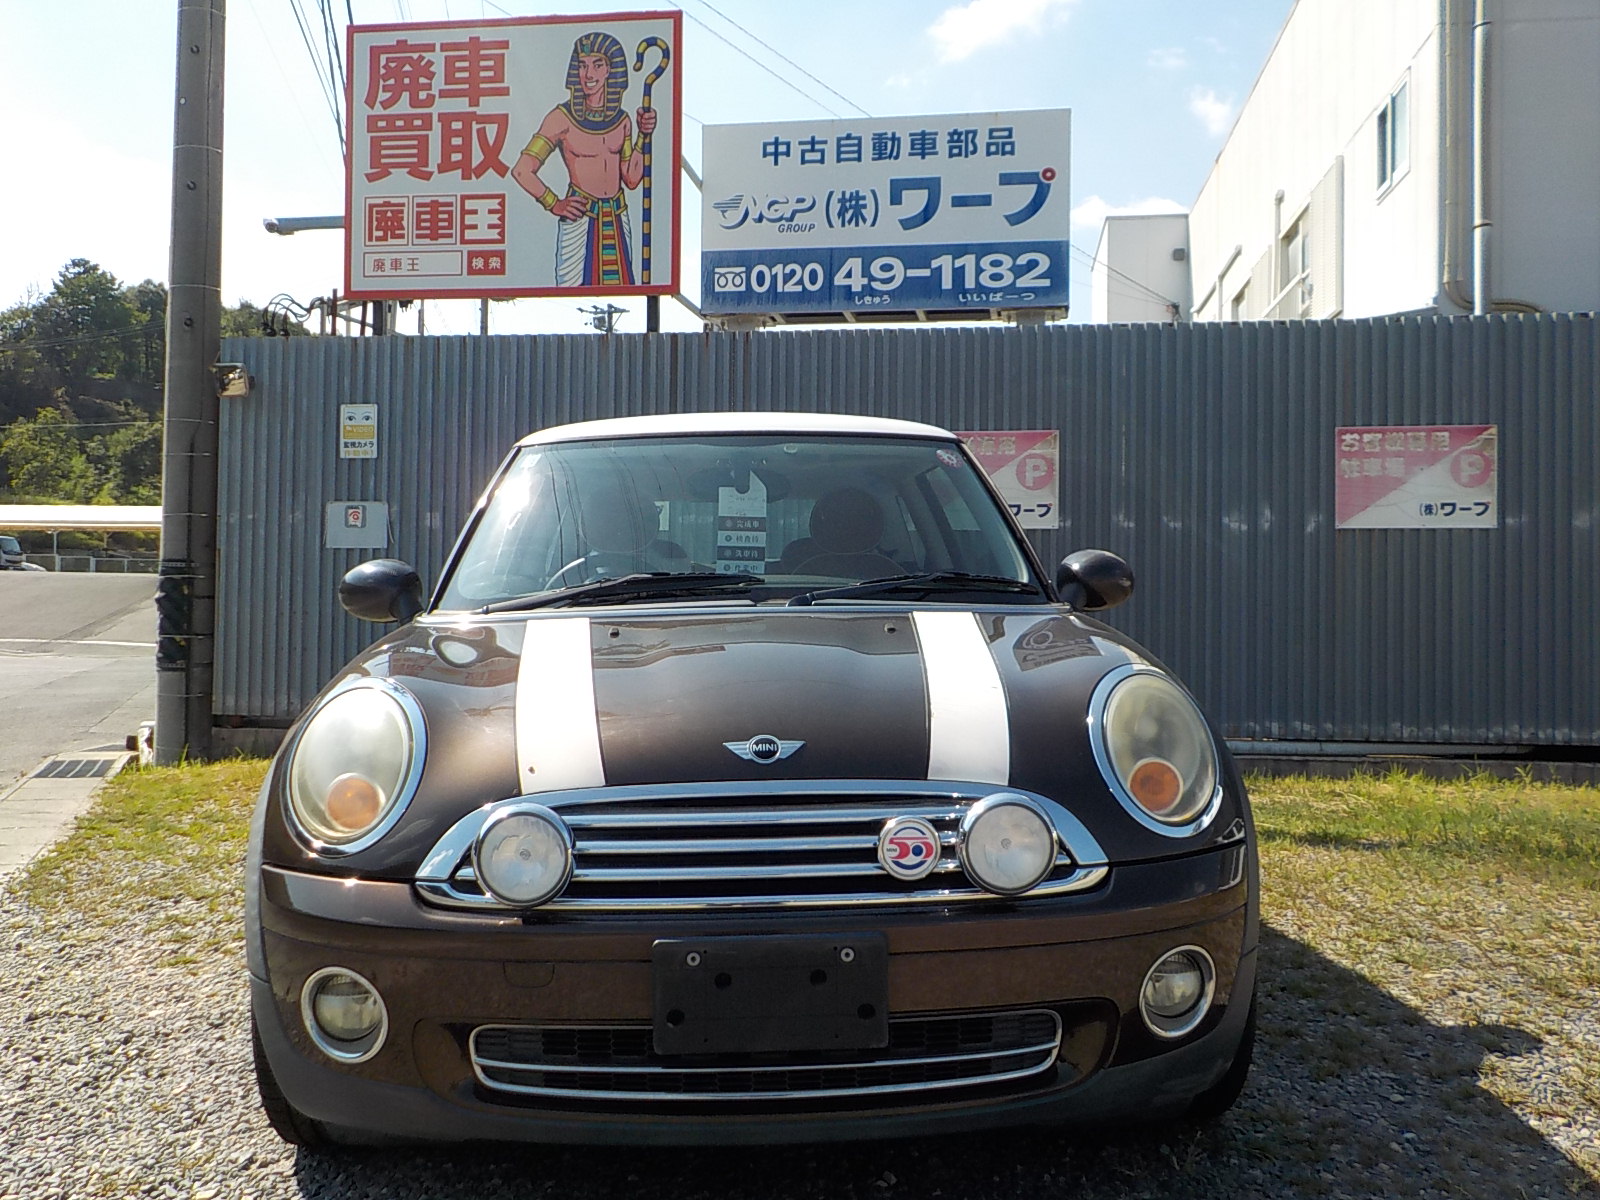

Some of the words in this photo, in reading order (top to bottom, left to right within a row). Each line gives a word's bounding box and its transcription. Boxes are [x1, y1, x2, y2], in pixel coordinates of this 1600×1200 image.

[364, 36, 510, 110] 廃車
[364, 111, 510, 183] 買取
[761, 126, 1016, 166] 中古自動車部品
[777, 223, 816, 233] GROUP
[372, 257, 421, 272] 廃車王
[471, 256, 502, 270] 検索
[750, 262, 824, 293] 0120
[834, 252, 1051, 292] 49-1182
[1025, 458, 1047, 487] P
[1460, 453, 1485, 483] P
[753, 743, 778, 752] MINI
